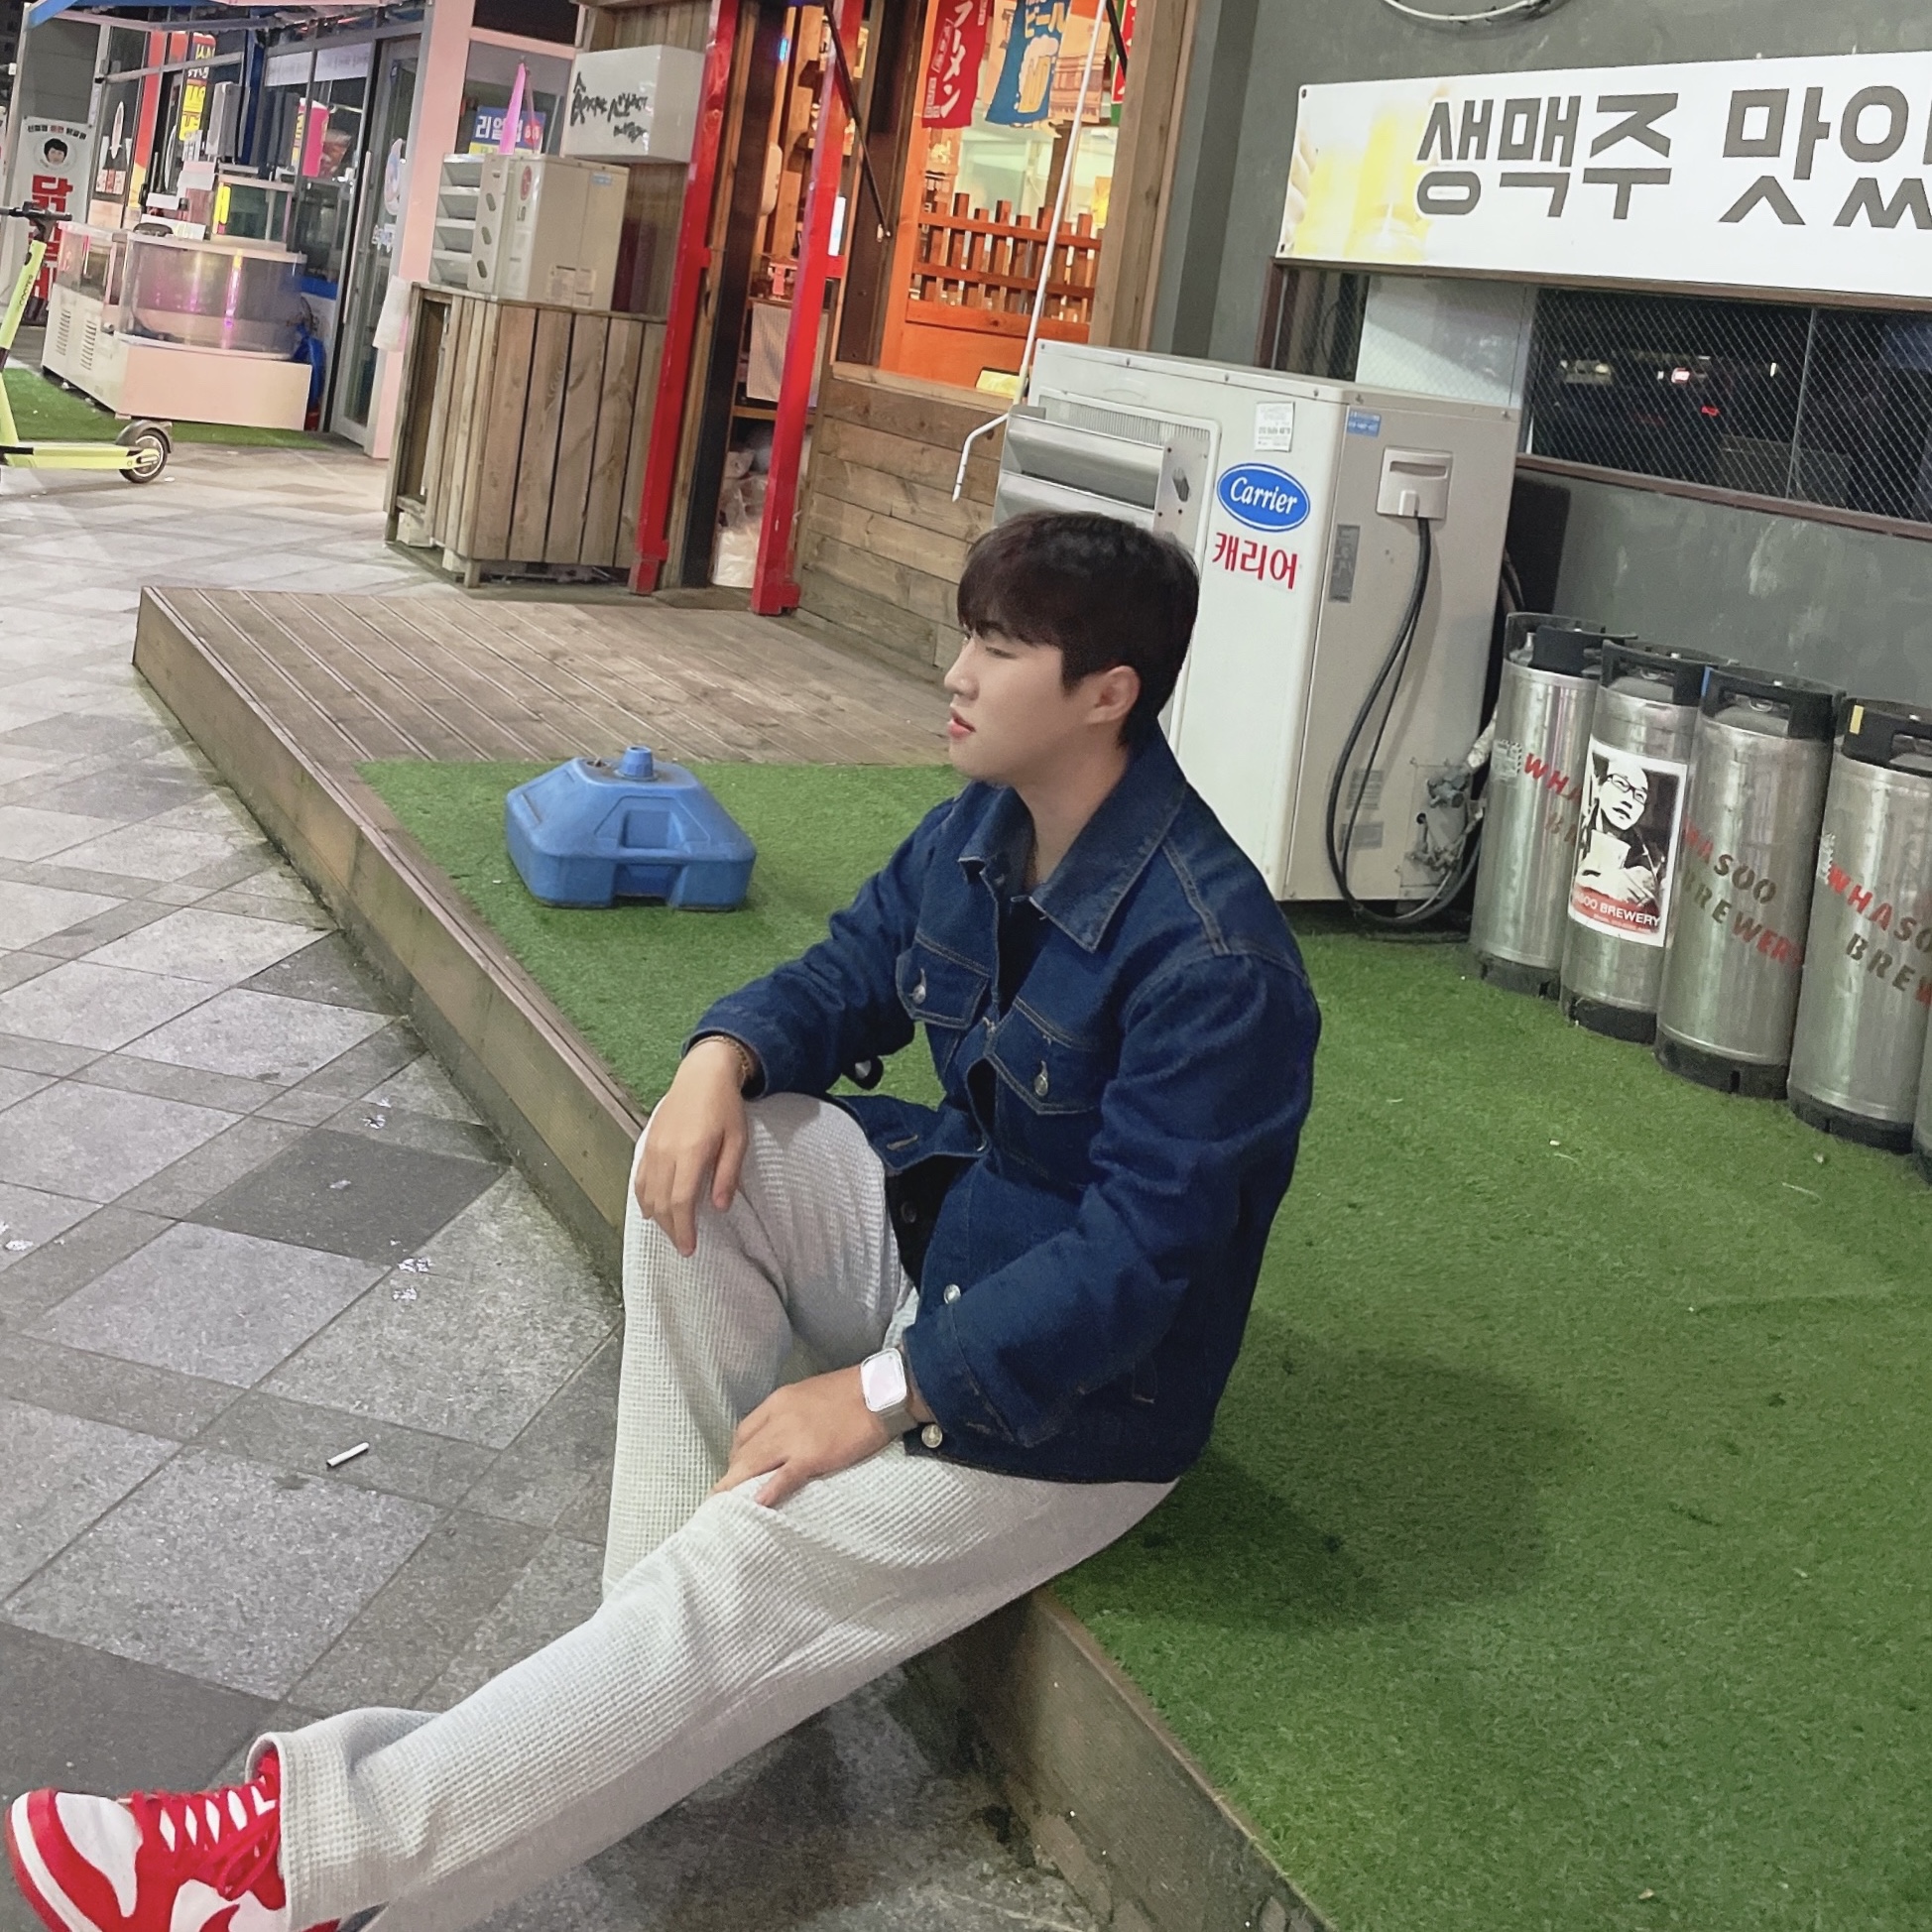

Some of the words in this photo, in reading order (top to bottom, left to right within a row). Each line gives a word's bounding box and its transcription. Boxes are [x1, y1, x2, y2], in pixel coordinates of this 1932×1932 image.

[1415, 92, 1679, 221] 생맥주
[1230, 476, 1298, 515] Carrier
[1212, 532, 1298, 590] 캐리어
[1599, 903, 1661, 926] BREWERY
